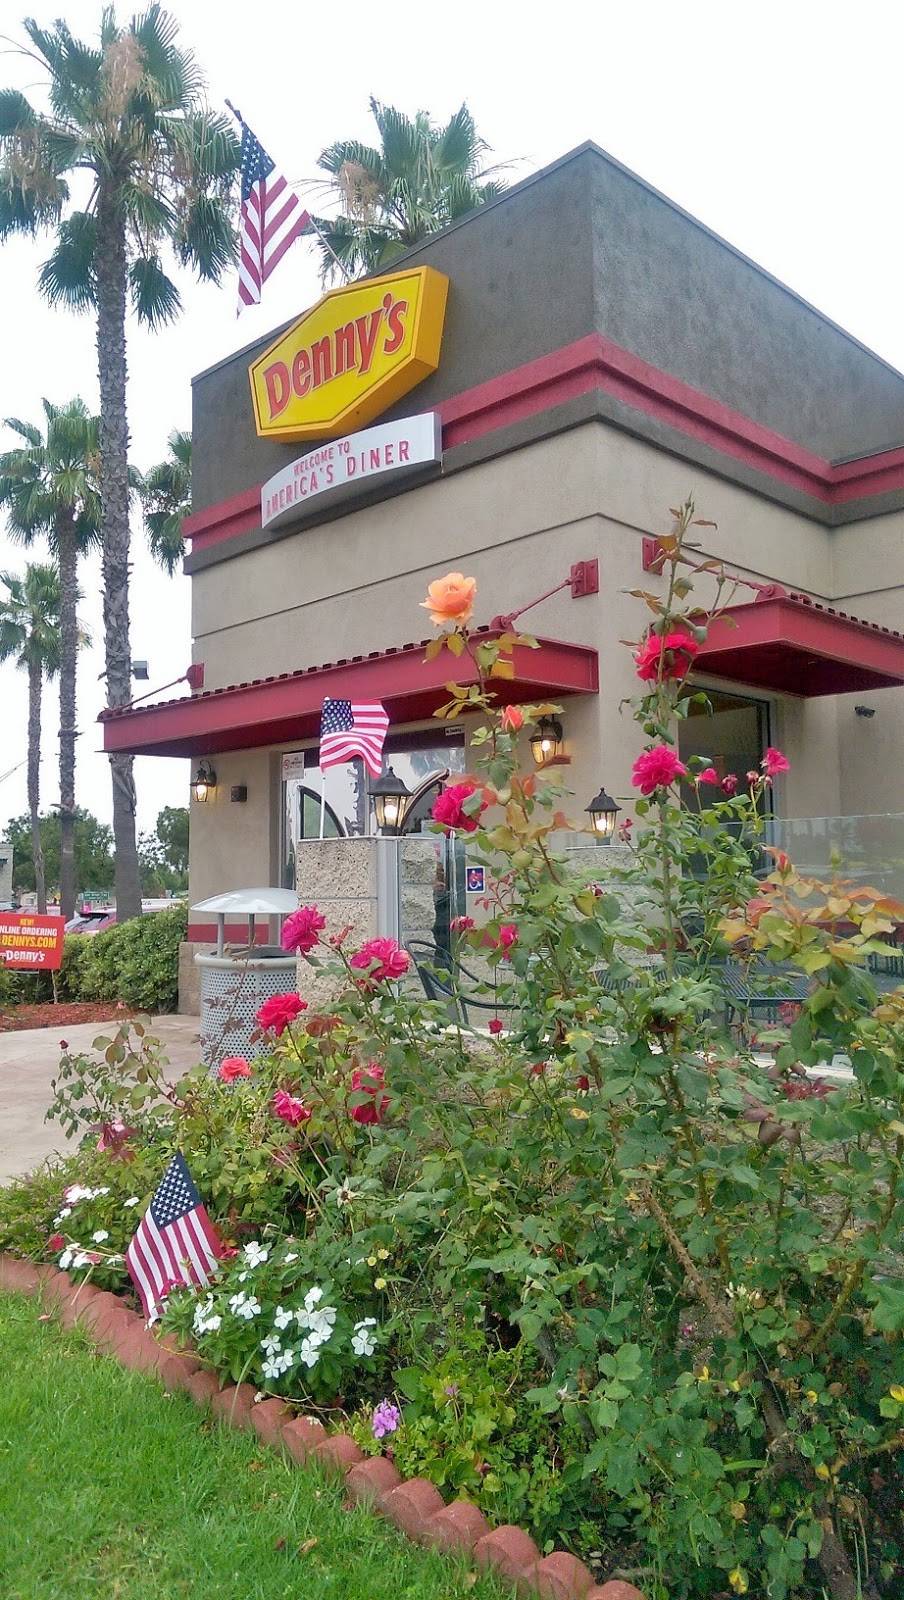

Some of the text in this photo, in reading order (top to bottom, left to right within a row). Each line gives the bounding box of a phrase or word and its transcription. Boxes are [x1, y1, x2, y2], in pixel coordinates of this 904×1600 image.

[262, 292, 408, 423] Denny's
[293, 441, 350, 476] WELCOME TO
[346, 440, 410, 476] DINER
[2, 934, 57, 949] DENNYS.COM
[21, 927, 58, 937] ORDERING
[5, 950, 46, 963] Denny's
